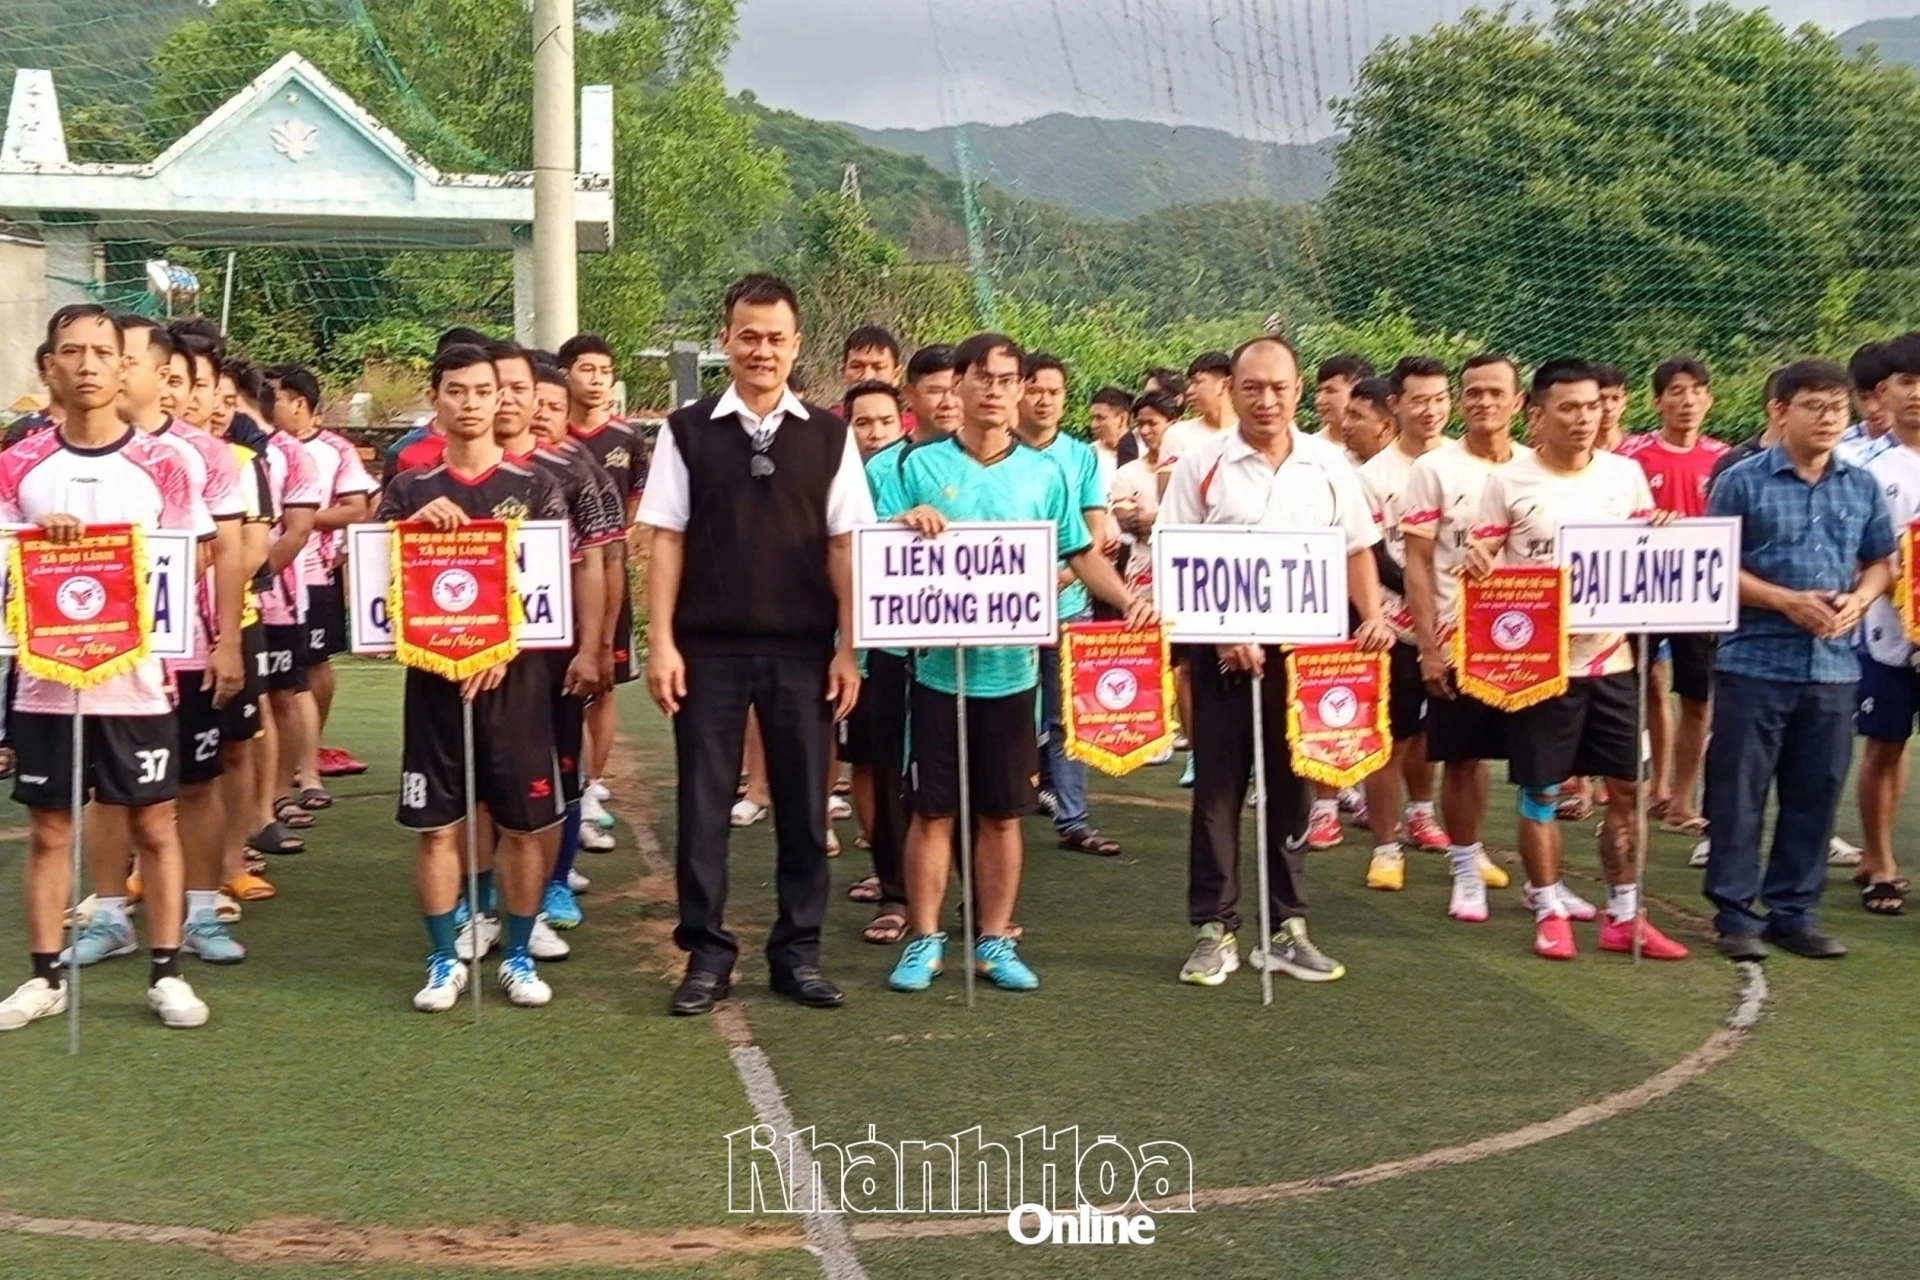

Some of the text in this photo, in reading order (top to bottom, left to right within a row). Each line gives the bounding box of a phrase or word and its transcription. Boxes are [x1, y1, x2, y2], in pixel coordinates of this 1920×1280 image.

[885, 536, 1026, 581] LIÊN QUÂN
[1570, 535, 1724, 617] ĐẠI LÃNH FC
[1171, 542, 1328, 625] TRỌNG TÀI
[870, 585, 1041, 630] TRƯỜNG HỌC
[135, 748, 170, 784] 37
